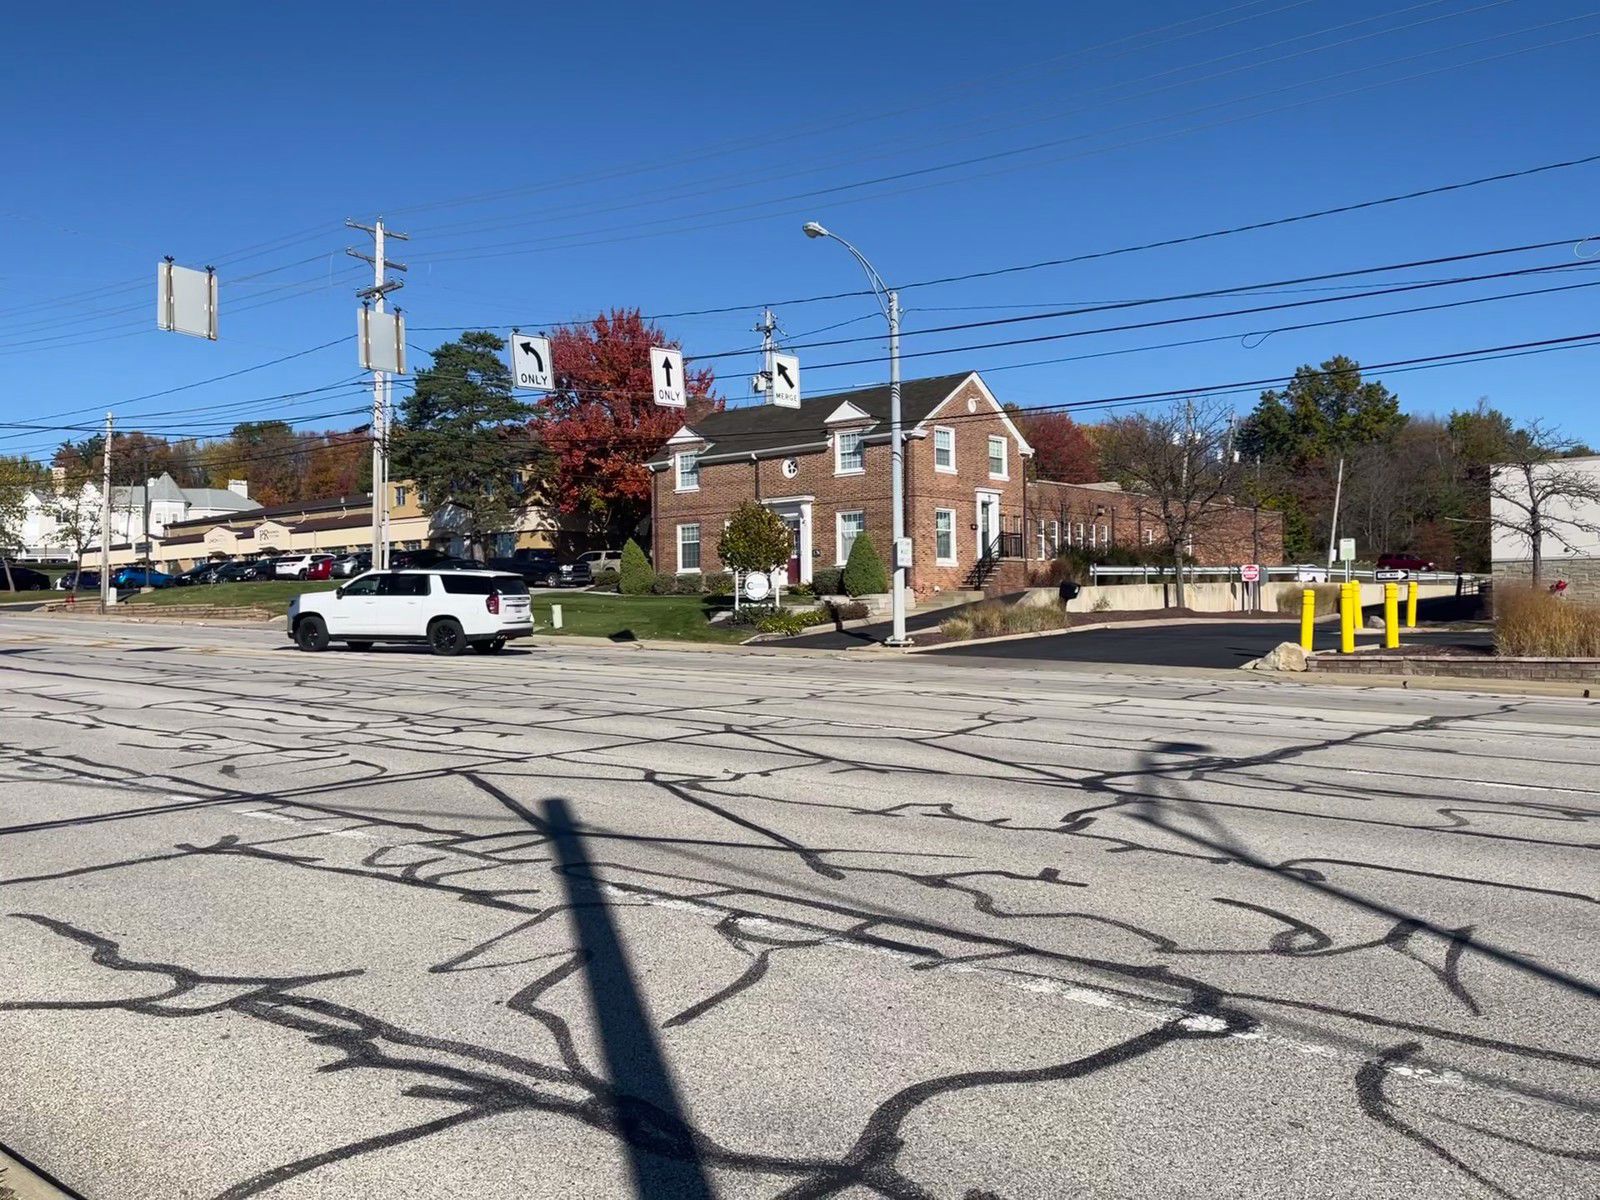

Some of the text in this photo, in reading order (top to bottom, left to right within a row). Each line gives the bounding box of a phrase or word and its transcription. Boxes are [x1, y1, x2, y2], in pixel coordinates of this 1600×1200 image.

[521, 373, 547, 385] ONLY
[659, 389, 680, 401] ONLY
[775, 392, 797, 402] MERGE
